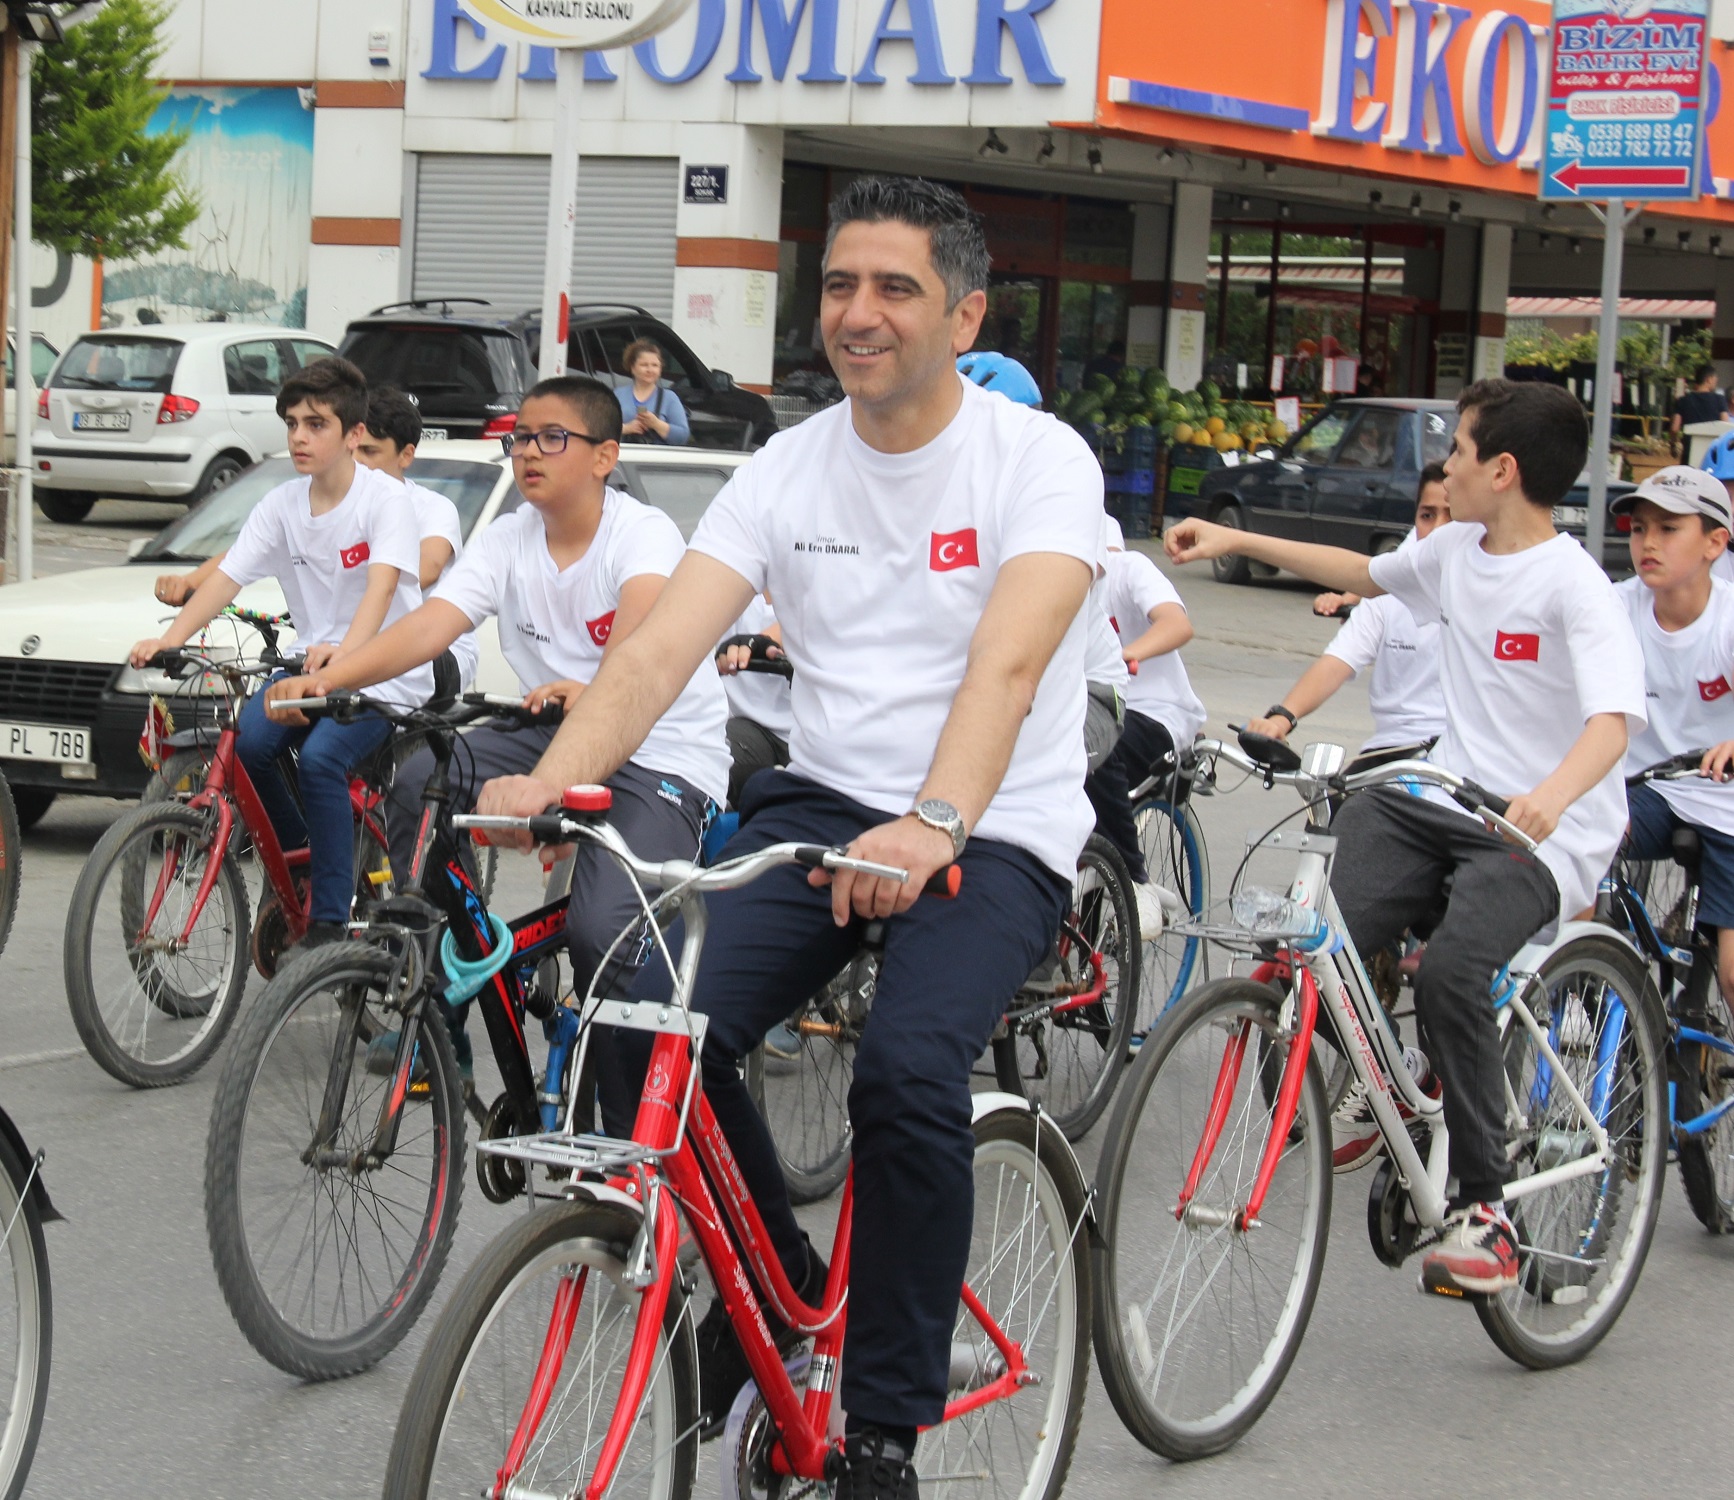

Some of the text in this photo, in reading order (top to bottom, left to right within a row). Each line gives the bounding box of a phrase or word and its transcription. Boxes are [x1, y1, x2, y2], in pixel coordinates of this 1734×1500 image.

[527, 0, 633, 20] KAHVALTI SALONU
[1558, 18, 1702, 52] BİZİM
[1557, 50, 1700, 72] BALIK EVİ
[1605, 73, 1622, 86] &
[1588, 123, 1623, 140] 0538
[1653, 123, 1672, 140] 83
[1673, 123, 1694, 140] 47
[1587, 140, 1693, 157] 0232 782 72 72
[10, 727, 84, 759] PL 788
